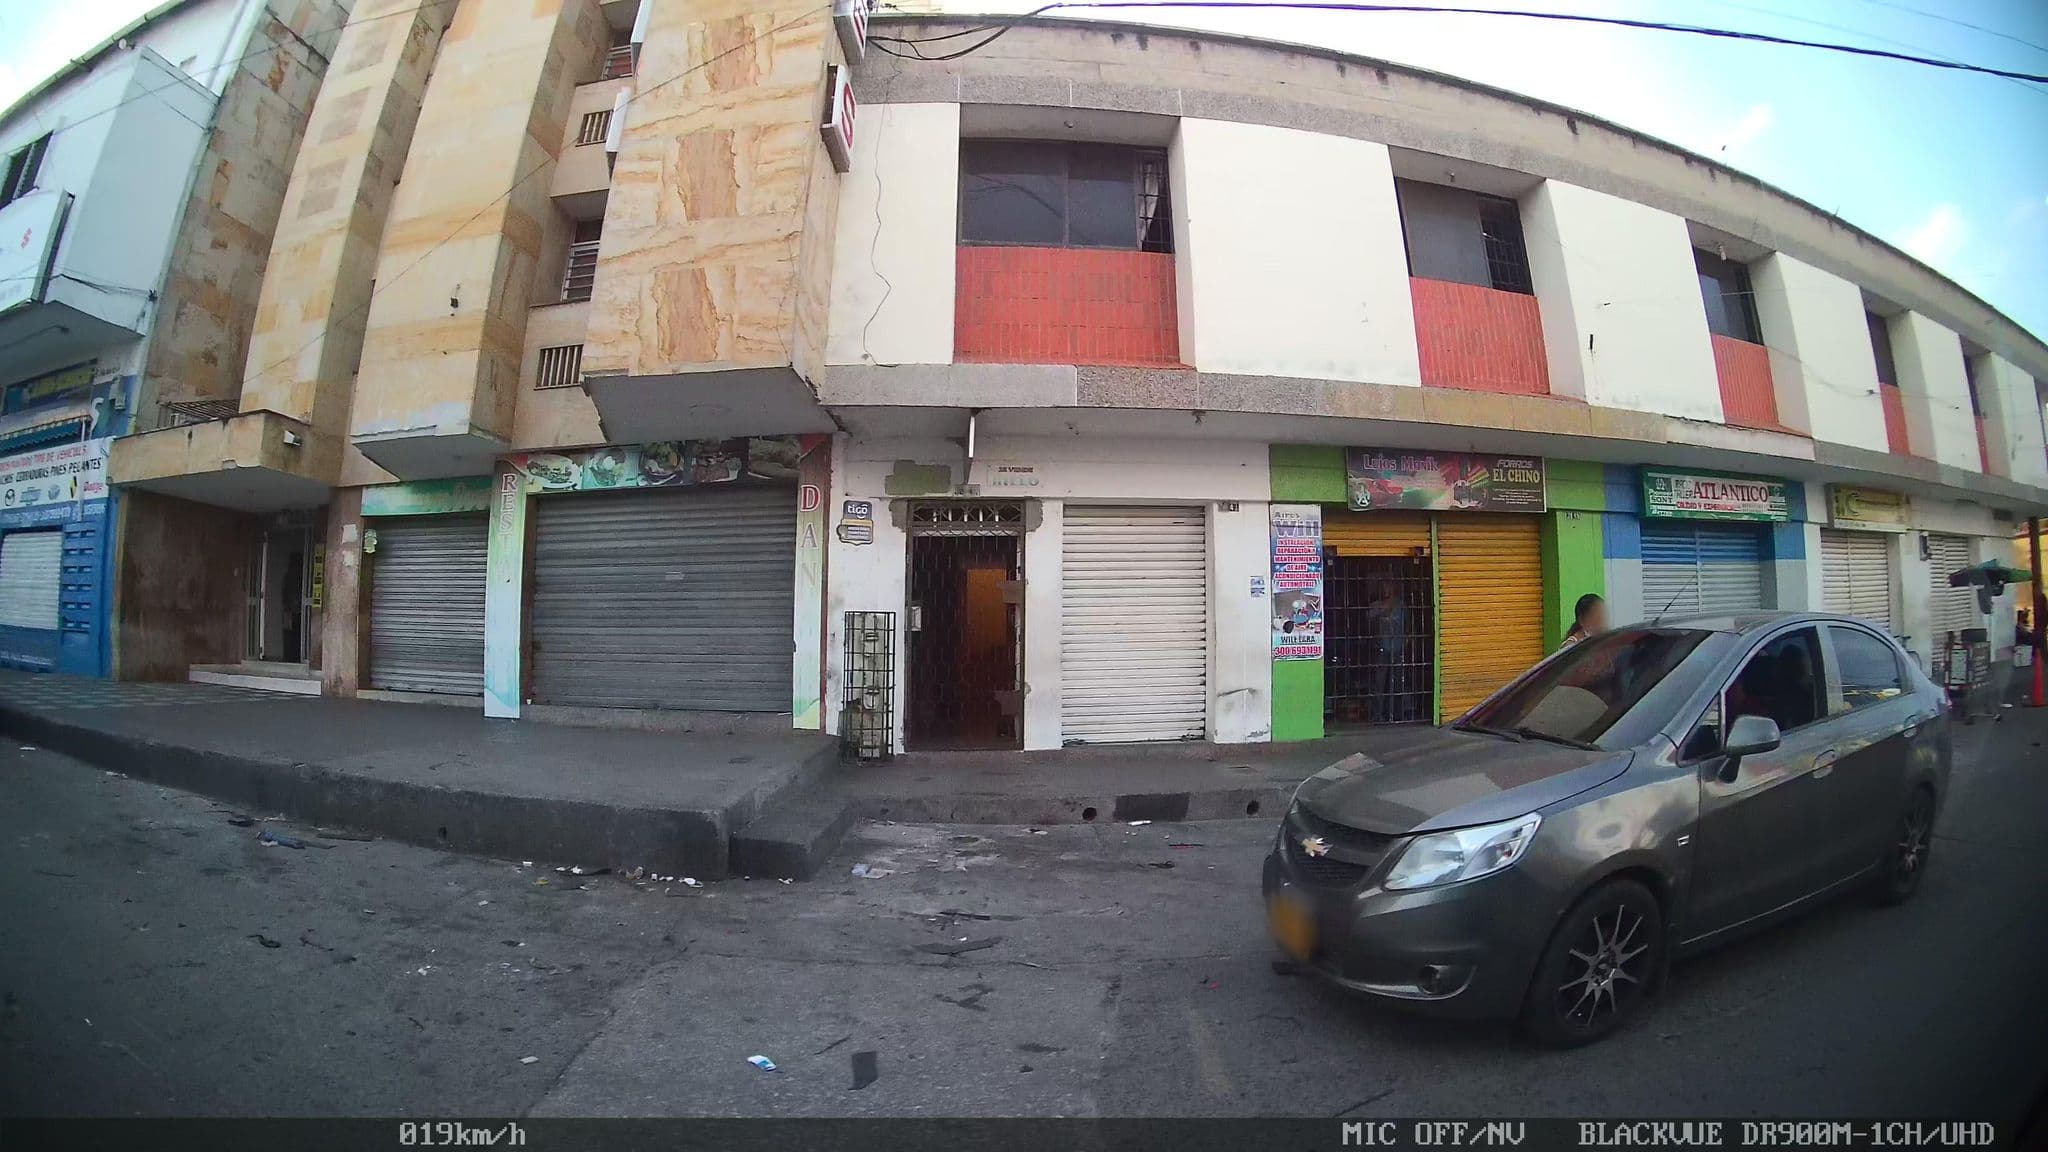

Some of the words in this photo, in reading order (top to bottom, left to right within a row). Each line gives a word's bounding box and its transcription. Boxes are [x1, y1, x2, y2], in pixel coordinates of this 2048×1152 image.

[1492, 468, 1506, 483] EL
[1507, 468, 1541, 484] CHINO
[1693, 481, 1769, 503] ATLANTICO
